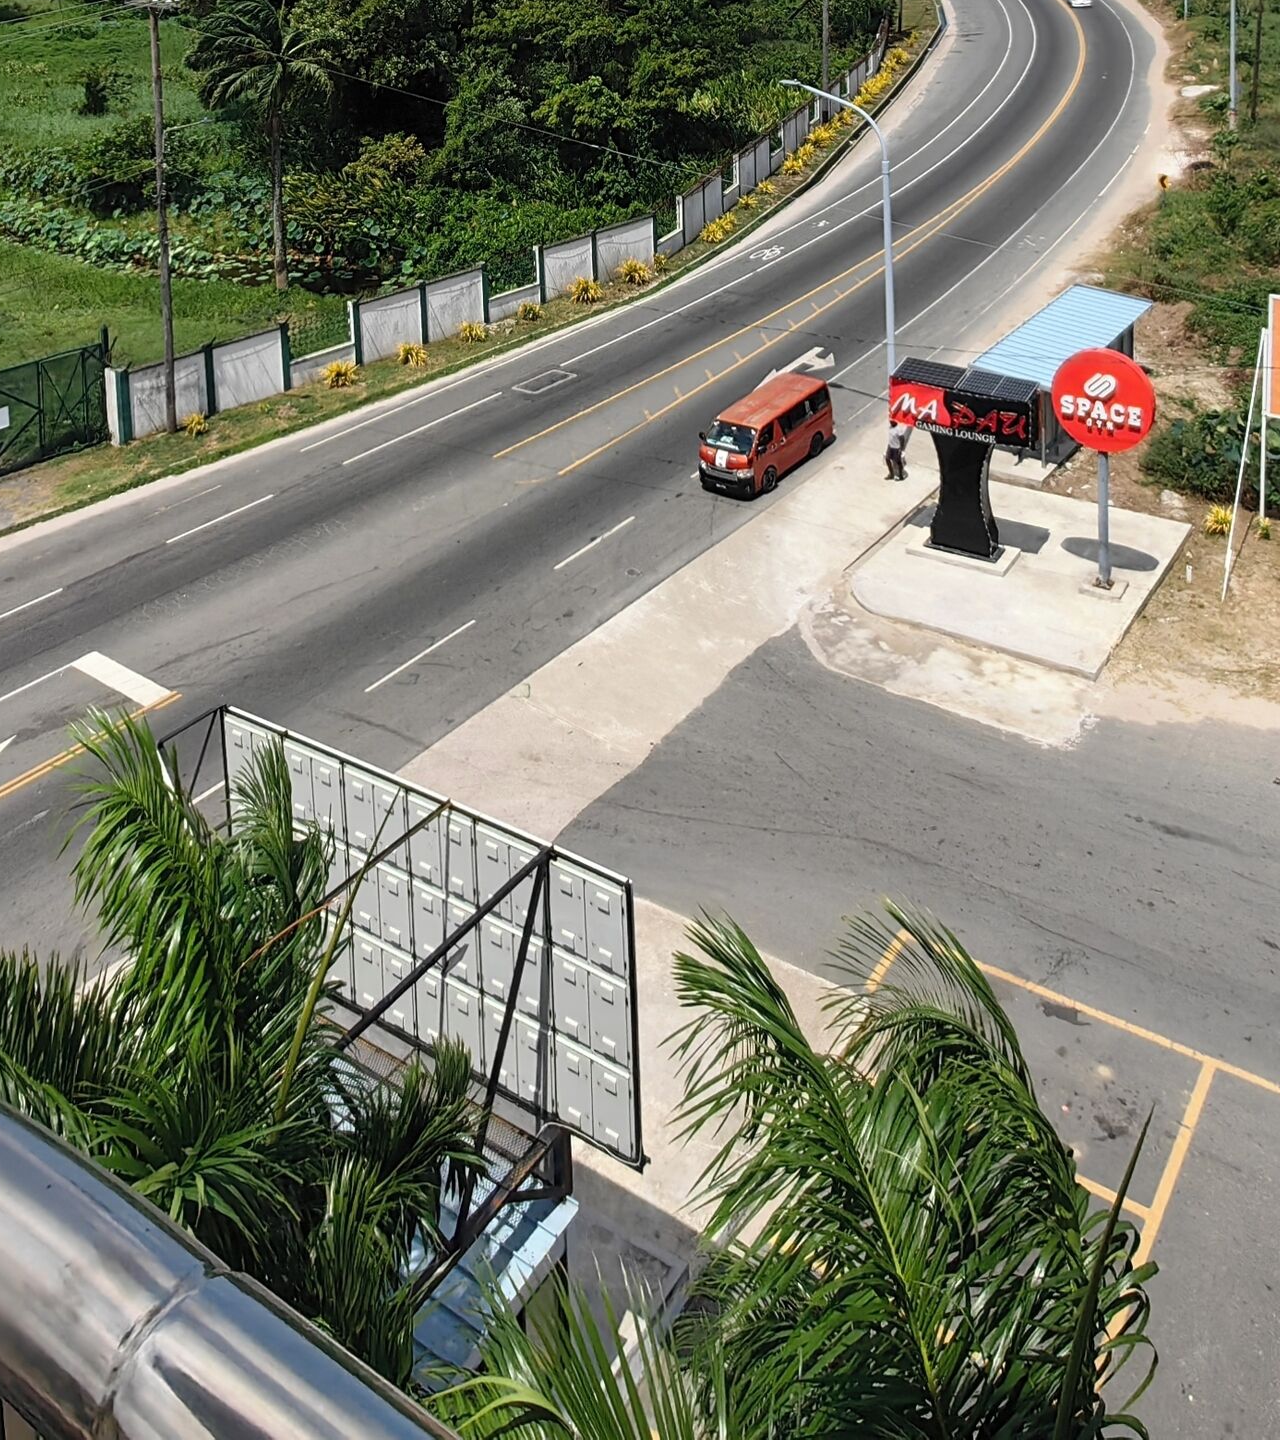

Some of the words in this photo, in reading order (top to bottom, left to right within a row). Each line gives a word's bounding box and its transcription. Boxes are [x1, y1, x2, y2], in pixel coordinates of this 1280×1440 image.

[891, 392, 937, 420] MA
[1059, 394, 1142, 427] SPACE
[915, 420, 953, 437] GAMING
[955, 429, 996, 444] LOUNGE
